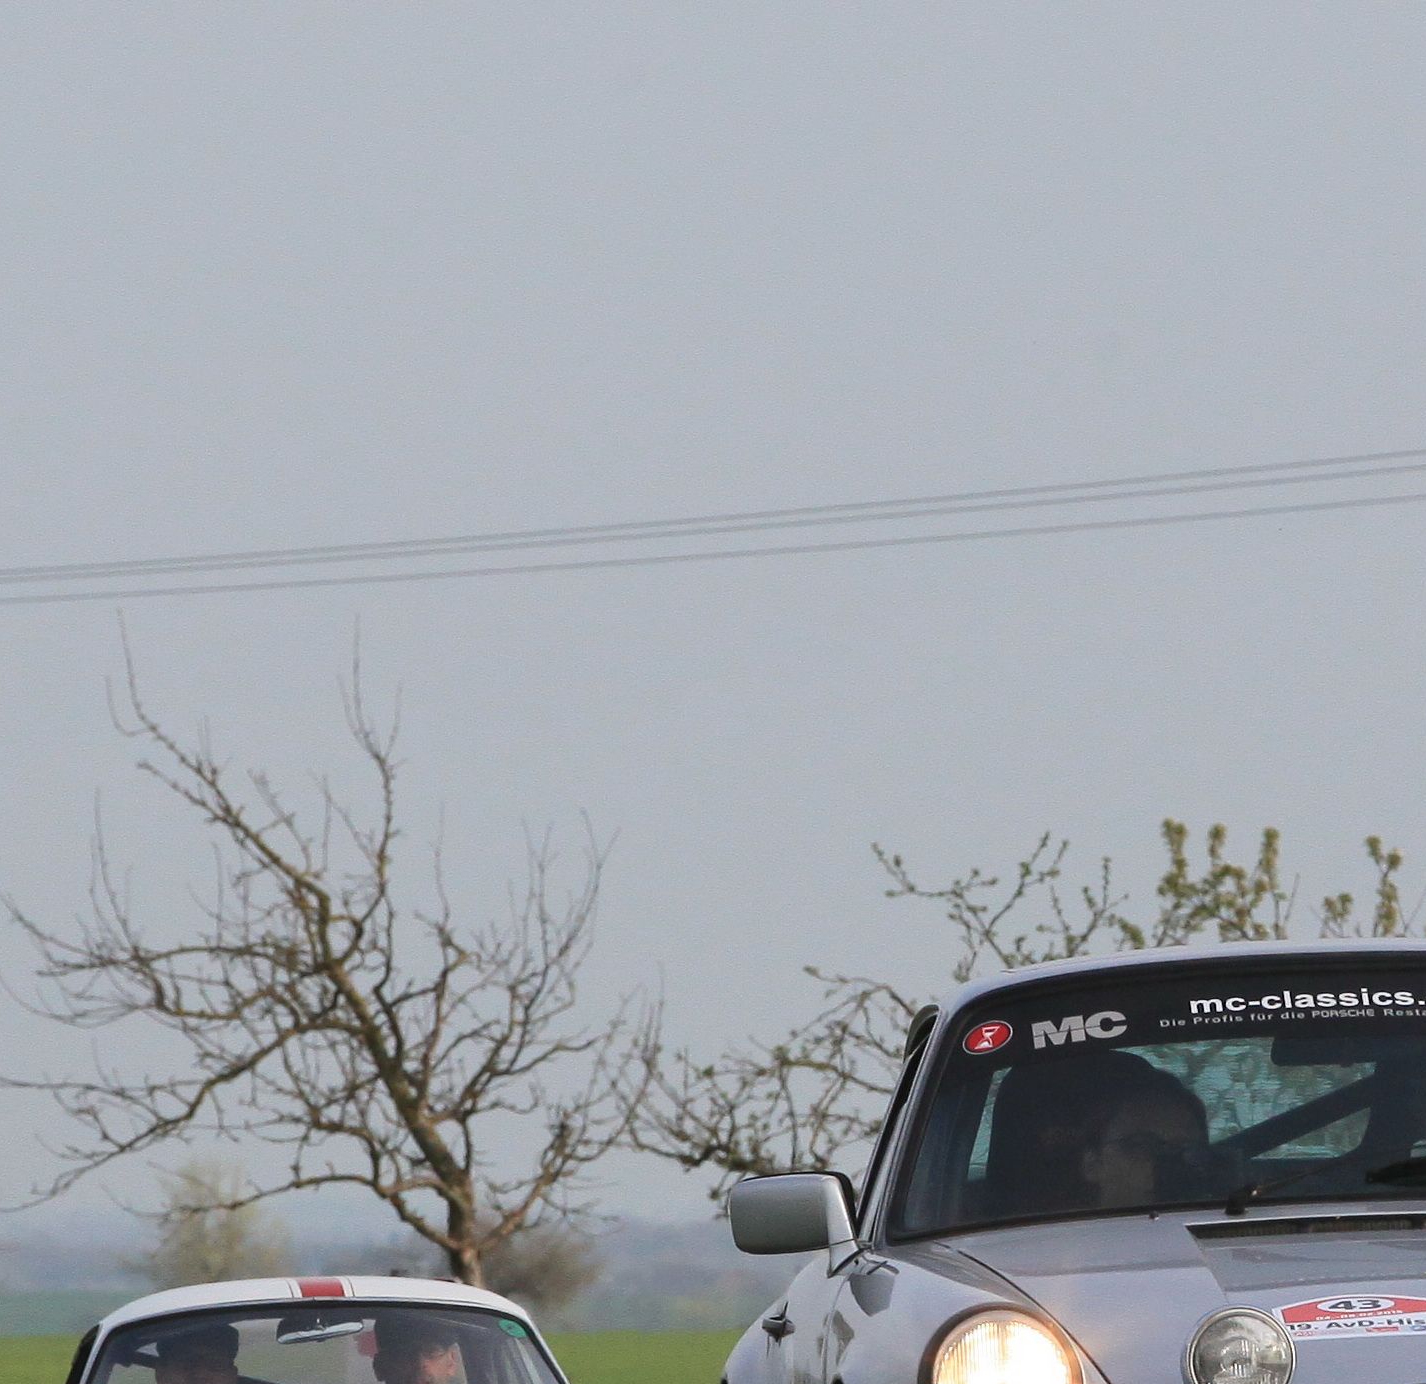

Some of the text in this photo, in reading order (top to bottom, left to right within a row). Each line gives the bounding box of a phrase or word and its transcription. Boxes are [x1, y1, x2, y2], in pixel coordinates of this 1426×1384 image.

[1159, 1018, 1186, 1028] Die
[1193, 1013, 1243, 1025] Profis
[1250, 1012, 1274, 1022] für
[1280, 1009, 1305, 1020] die
[1312, 1008, 1375, 1019] PORSCHE
[1031, 1010, 1128, 1050] MC
[1328, 1299, 1382, 1310] 43
